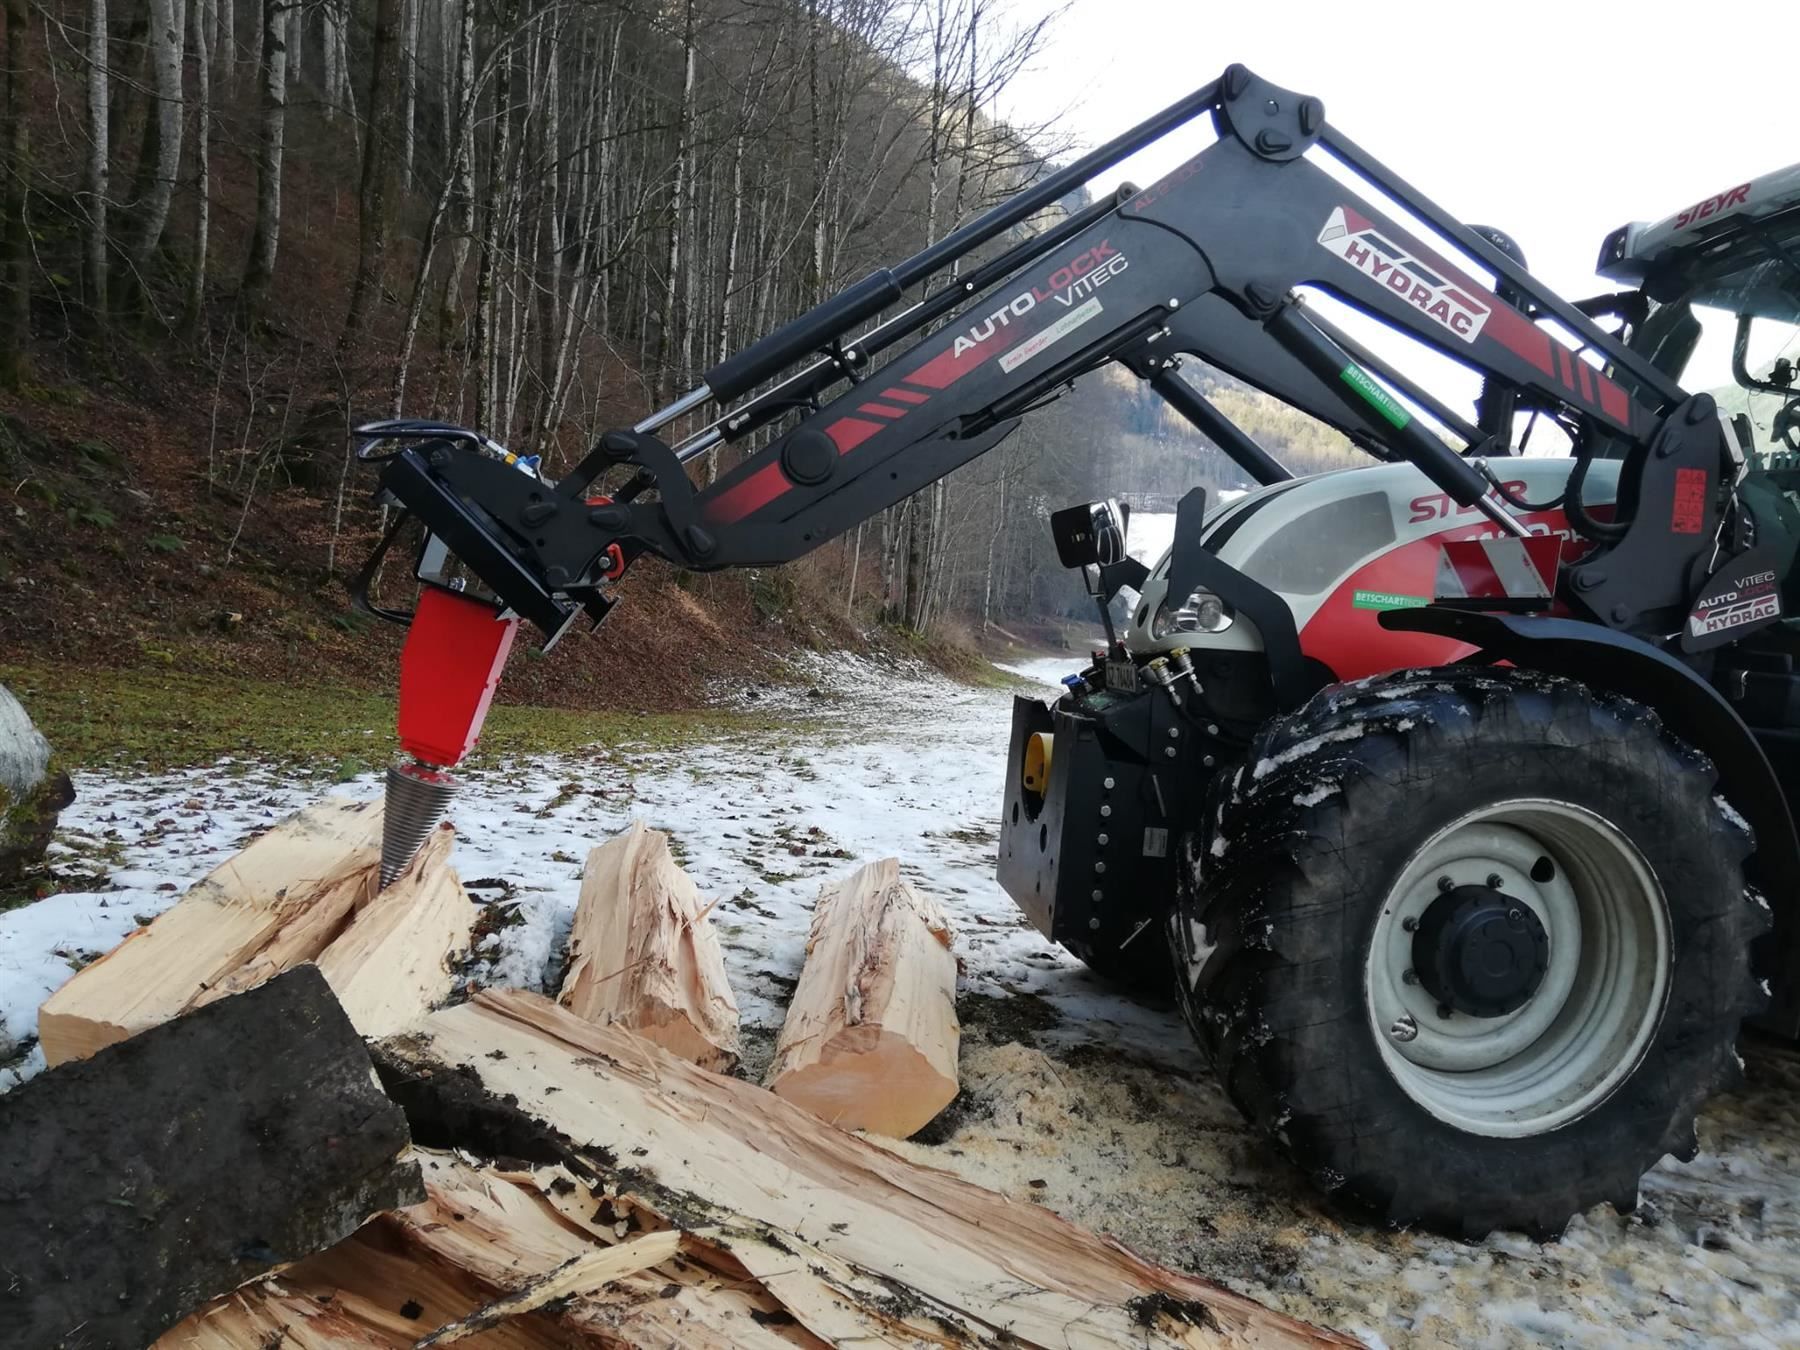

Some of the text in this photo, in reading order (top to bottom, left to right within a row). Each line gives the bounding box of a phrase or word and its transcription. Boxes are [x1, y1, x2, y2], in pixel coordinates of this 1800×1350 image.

[1673, 183, 1751, 230] STEYR
[1344, 240, 1473, 336] HYDRAC
[1408, 480, 1528, 524] STR
[1706, 604, 1776, 631] HYDRAC
